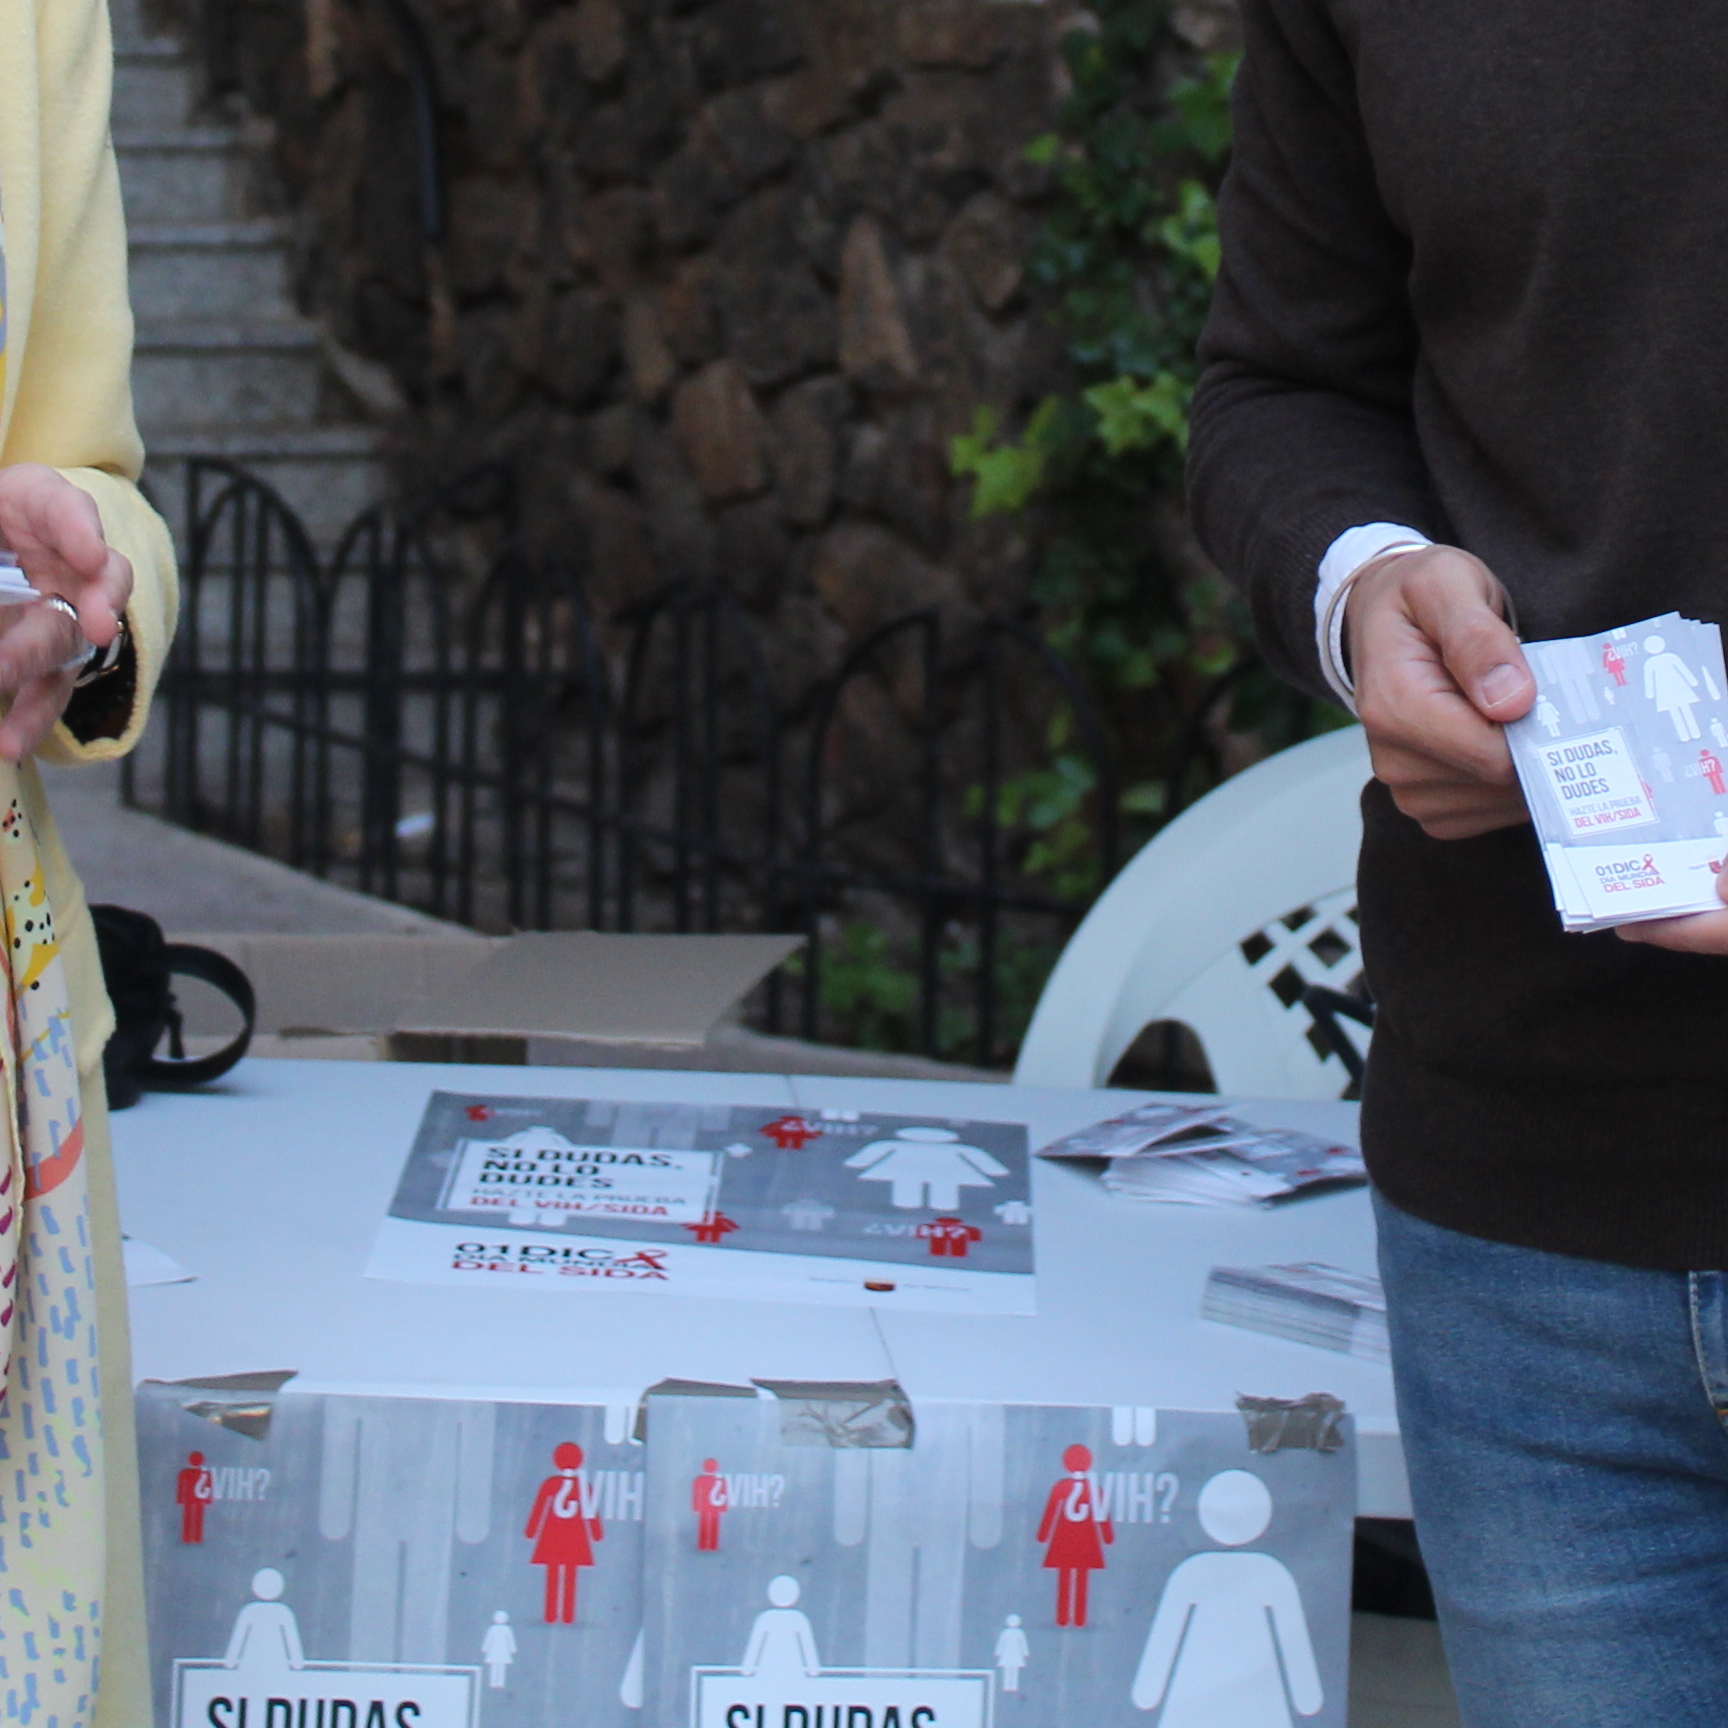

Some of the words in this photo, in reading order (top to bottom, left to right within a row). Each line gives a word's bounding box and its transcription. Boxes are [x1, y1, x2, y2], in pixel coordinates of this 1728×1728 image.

[1546, 750, 1564, 767] SI
[1553, 767, 1576, 784] NO
[1576, 761, 1597, 778] LO
[1560, 777, 1610, 800] DUDES
[1569, 802, 1597, 816] HAZTE
[1597, 801, 1610, 812] LA
[1574, 815, 1595, 828] DEL
[1594, 806, 1642, 825] VIH/SIDA
[1595, 859, 1642, 877] 01DIC
[1603, 881, 1632, 893] DEL
[1632, 875, 1666, 889] SIDA
[486, 1146, 523, 1160] SI
[482, 1159, 537, 1173] NO
[553, 1162, 601, 1176] LO
[478, 1171, 614, 1189] DUDES
[534, 1199, 669, 1217] VIH/SIDA
[452, 1261, 544, 1275] DEL
[558, 1265, 669, 1281] SIDA
[194, 1467, 270, 1502] ¿VIH?
[709, 1472, 786, 1509] ¿VIH?
[553, 1468, 645, 1522] ¿VIH
[1064, 1471, 1179, 1525] ¿VIH?
